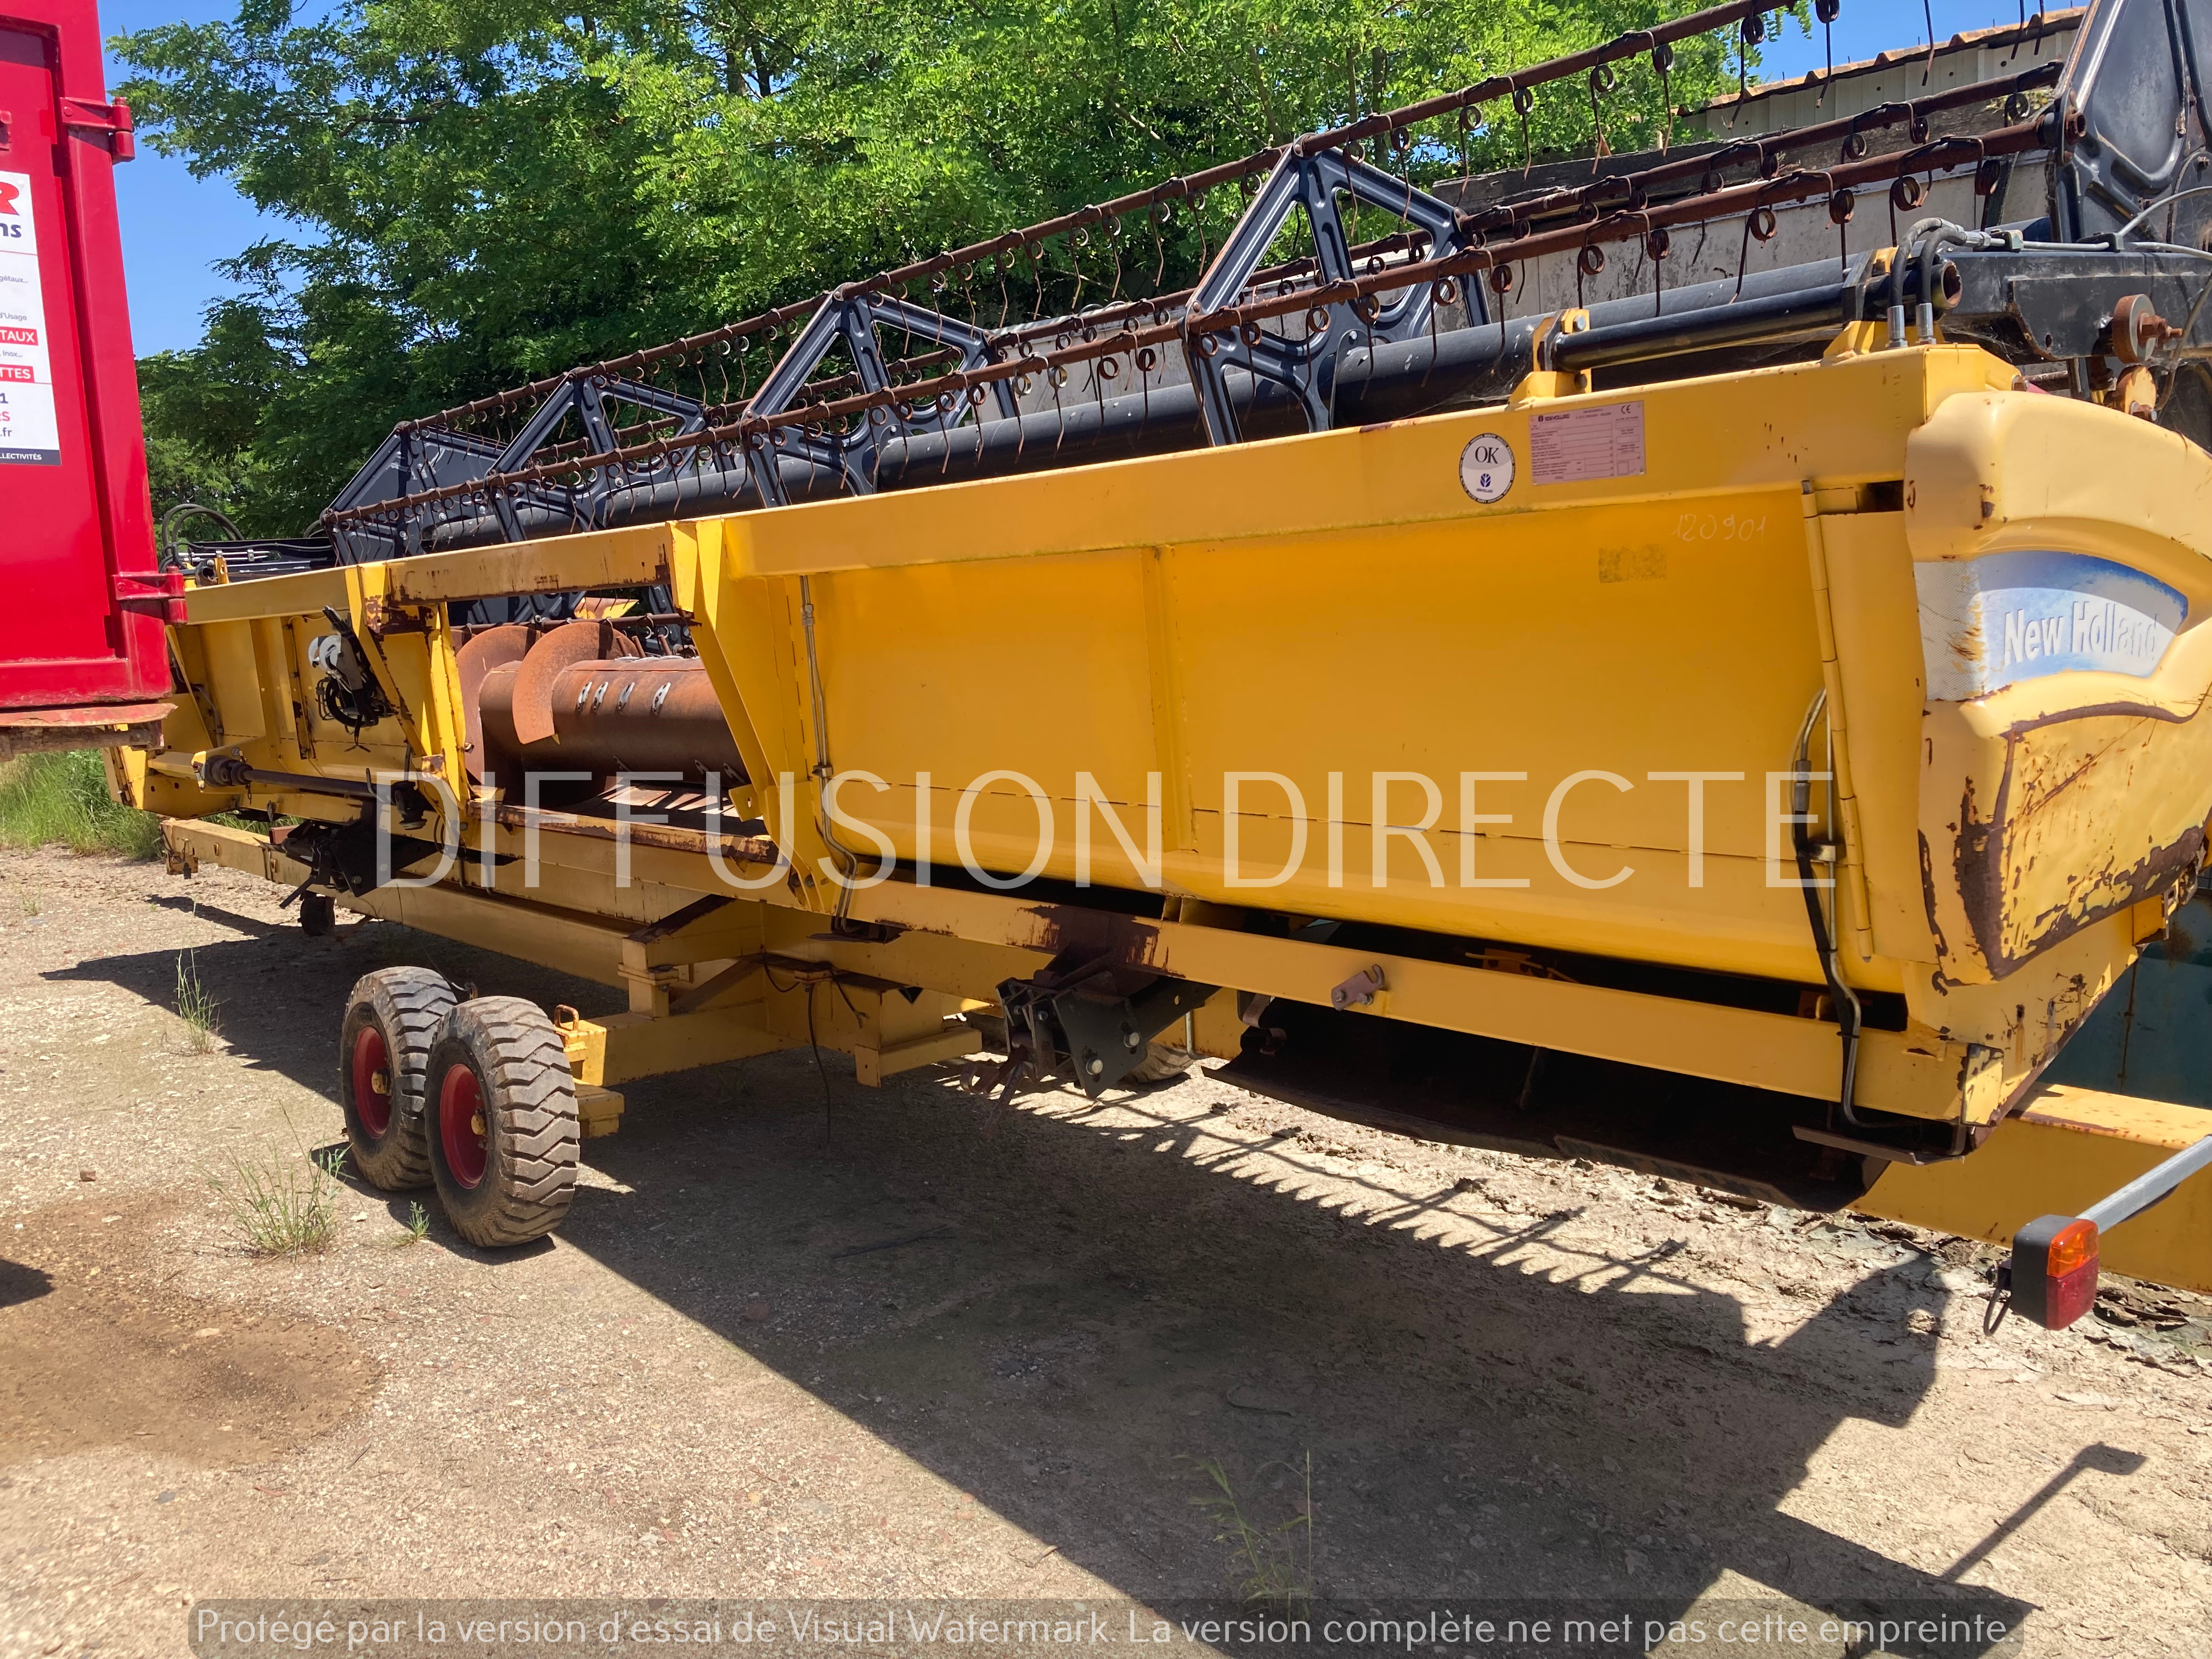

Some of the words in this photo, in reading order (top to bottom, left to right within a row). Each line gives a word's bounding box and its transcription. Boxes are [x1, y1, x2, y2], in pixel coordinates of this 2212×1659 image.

[0, 411, 10, 422] S
[1475, 445, 1499, 464] OK
[2004, 608, 2063, 666] New
[2072, 601, 2160, 661] Holland
